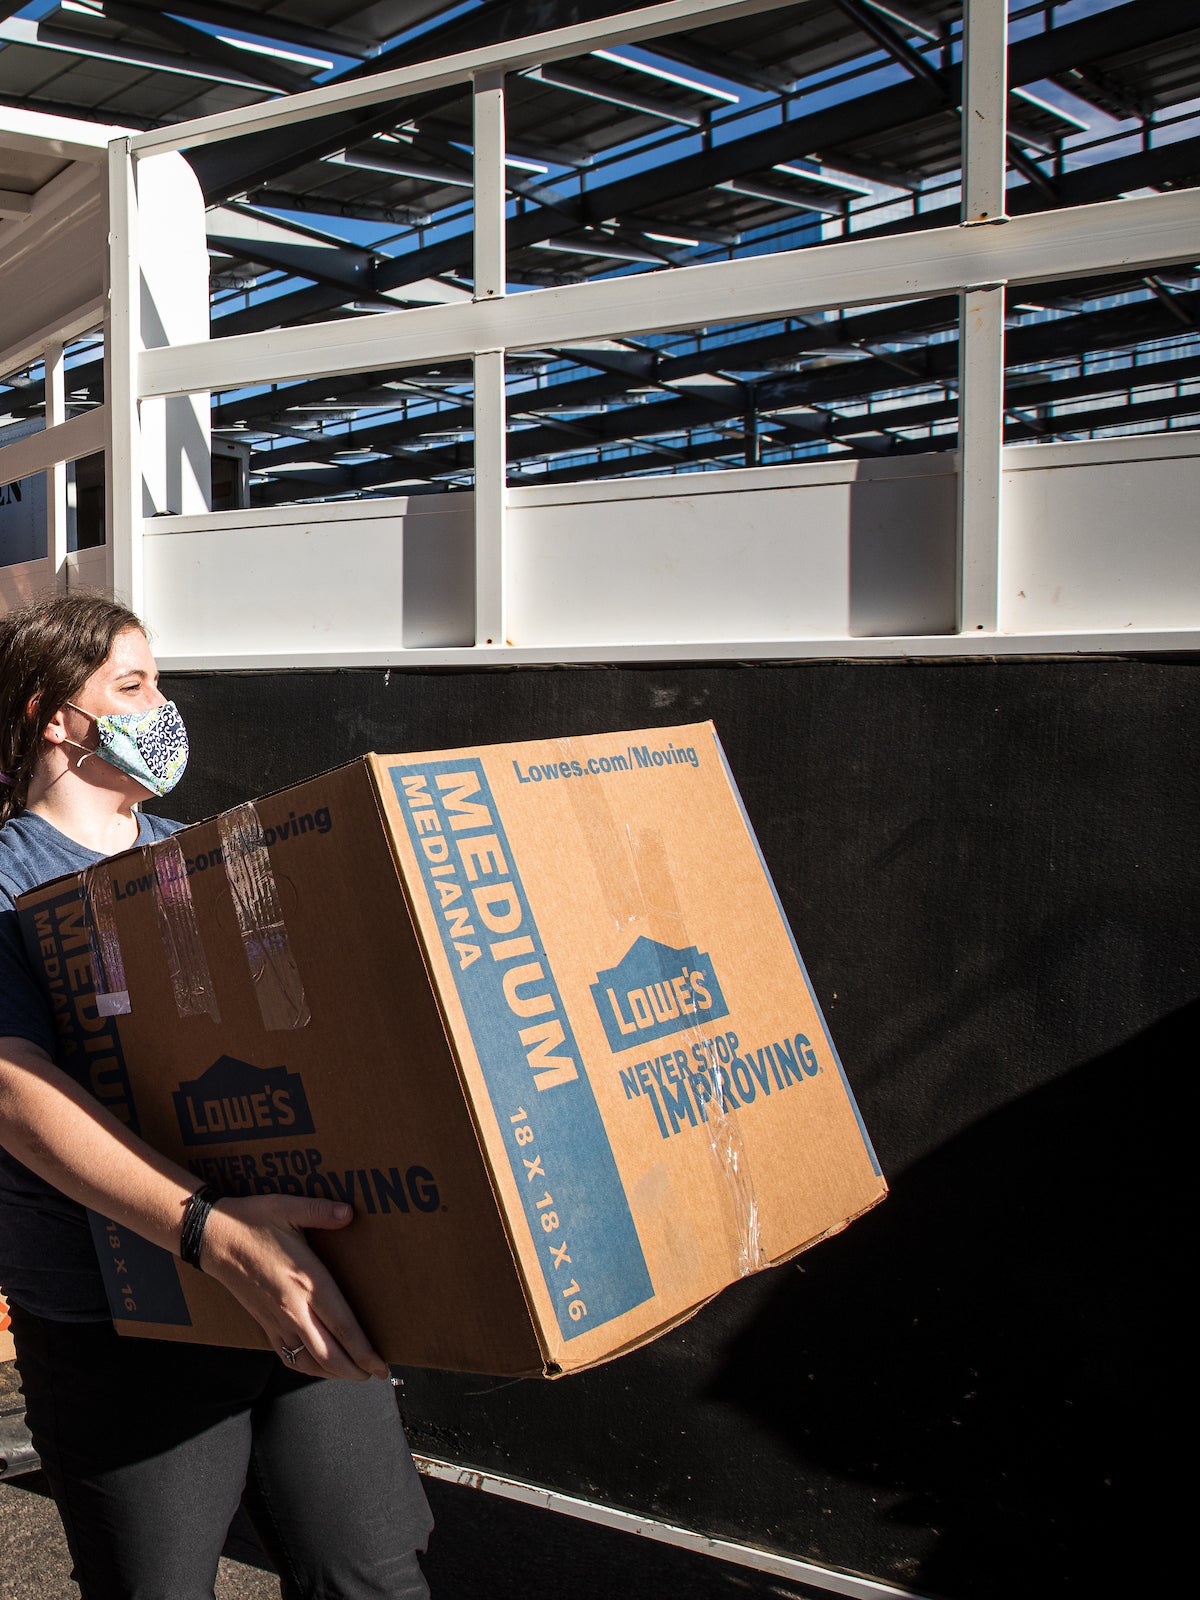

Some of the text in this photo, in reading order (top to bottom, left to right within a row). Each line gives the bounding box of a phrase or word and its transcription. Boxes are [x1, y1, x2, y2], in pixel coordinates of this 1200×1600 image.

[514, 742, 700, 784] Lowes.com/Moving
[400, 775, 482, 972] MEDIANA
[431, 768, 580, 1092] MEDIUM
[33, 909, 78, 1056] MEDIANA
[606, 967, 711, 1036] LOWE'S
[618, 1031, 740, 1101] NEVER STOP
[643, 1033, 818, 1140] IMPROVING
[186, 1084, 296, 1135] LOWE'S
[188, 1148, 322, 1182] NEVER STOP
[509, 1106, 588, 1321] 18 X 18 X 16
[113, 1256, 128, 1274] X
[121, 1283, 137, 1312] 16
